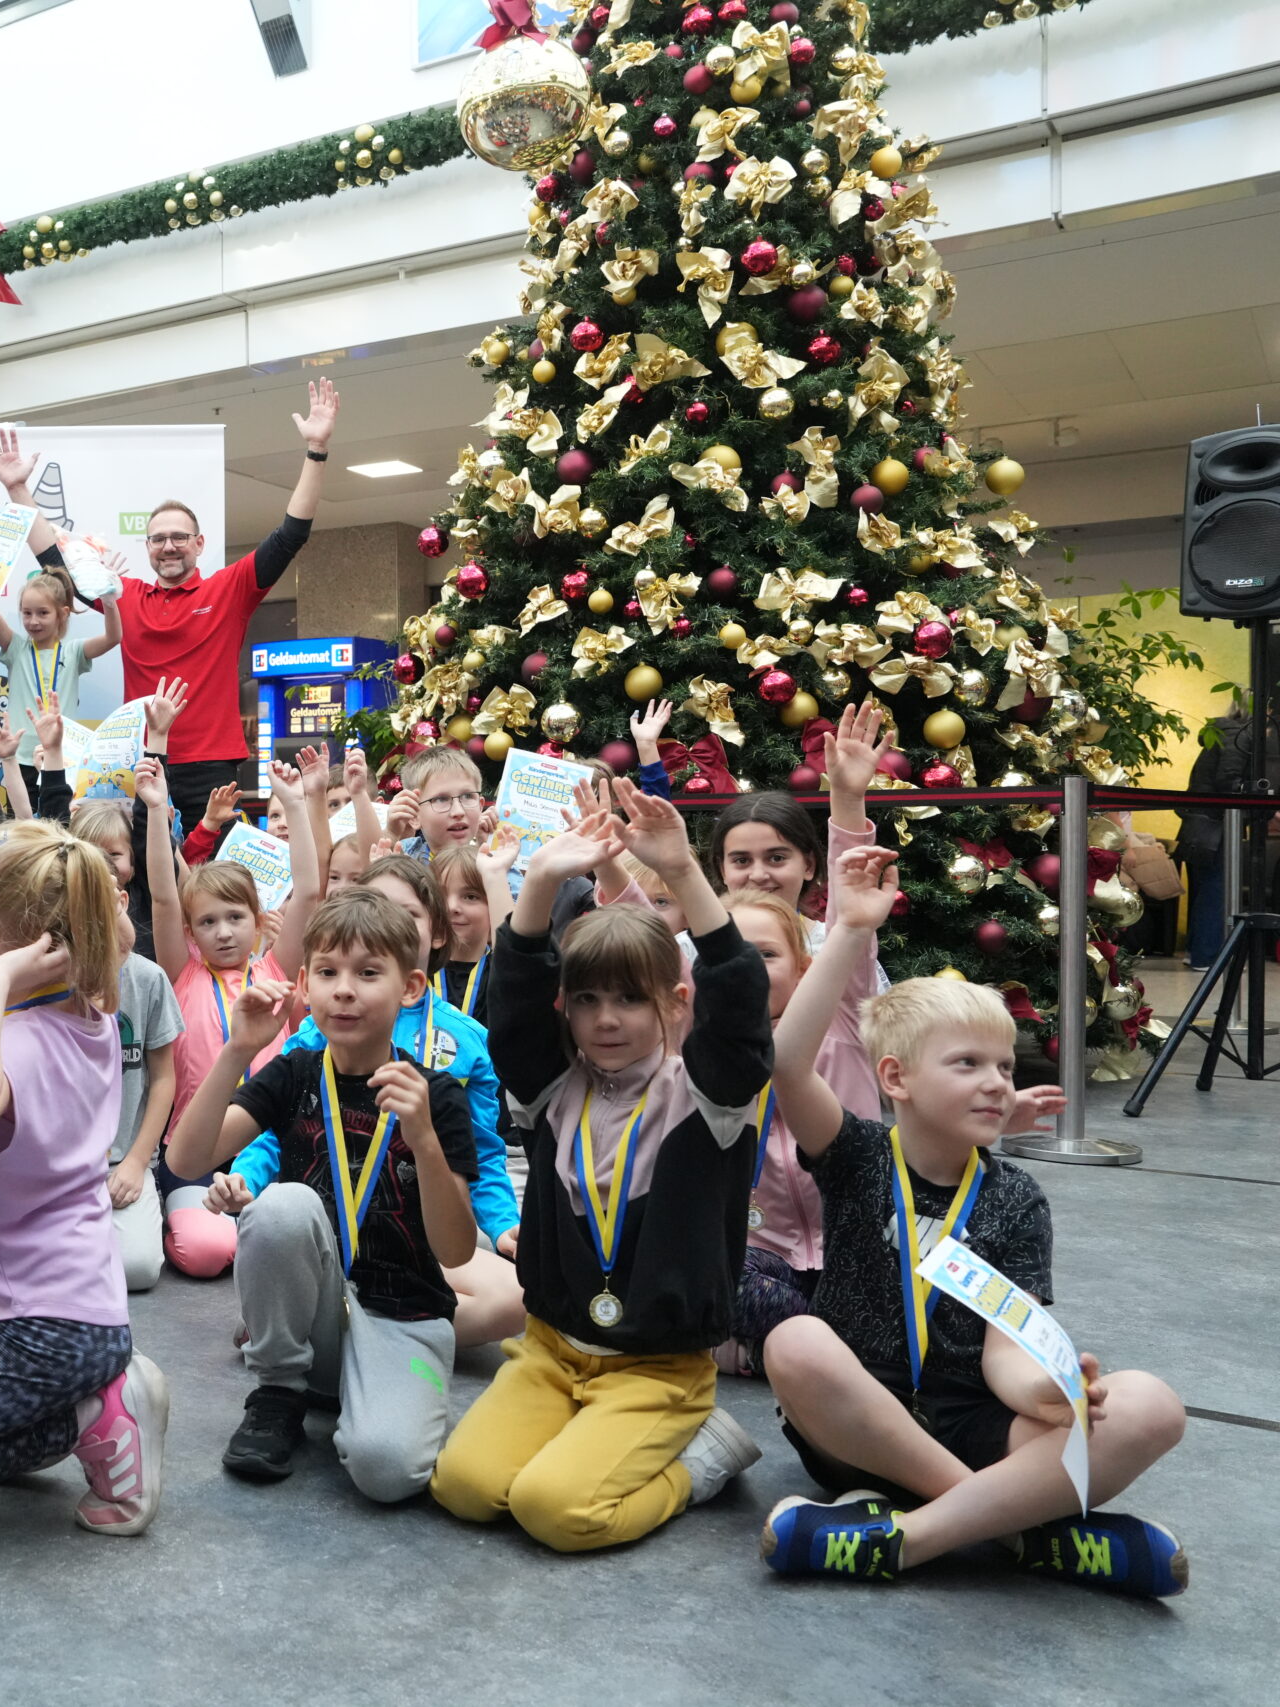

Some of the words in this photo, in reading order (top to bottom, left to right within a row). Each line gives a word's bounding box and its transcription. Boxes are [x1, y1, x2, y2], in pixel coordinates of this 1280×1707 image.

[123, 515, 150, 531] VB
[269, 650, 330, 666] Geldautomat
[511, 769, 575, 797] Gewinne
